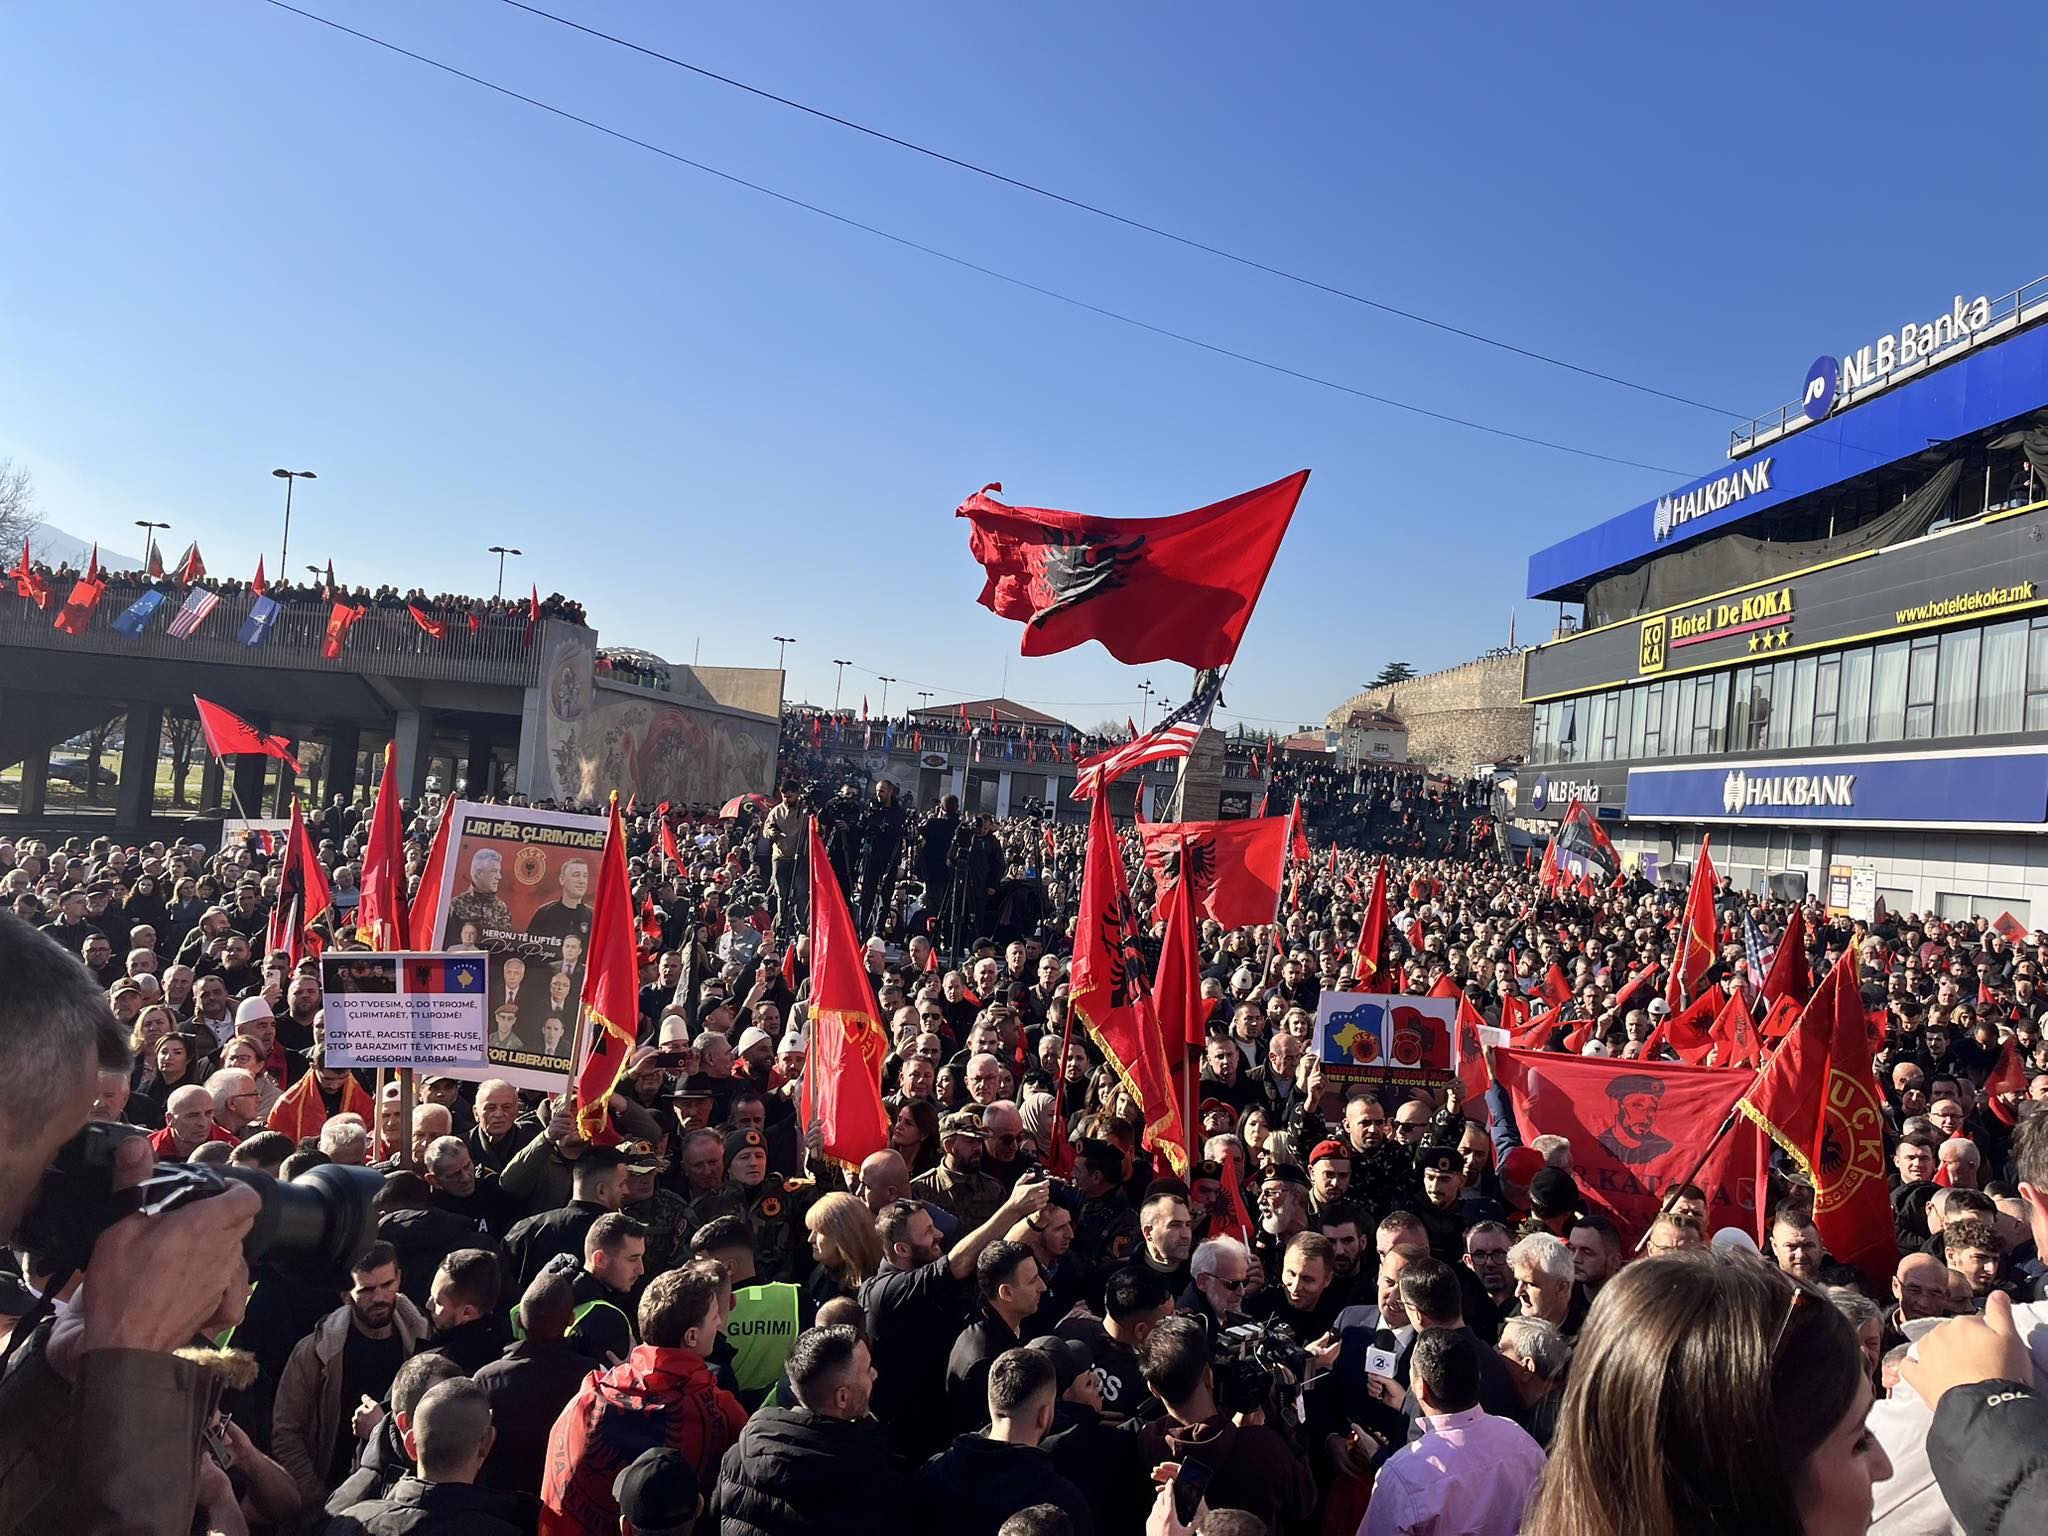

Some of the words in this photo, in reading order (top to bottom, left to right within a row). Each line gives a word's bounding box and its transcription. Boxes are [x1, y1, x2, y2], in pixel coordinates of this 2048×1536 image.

[1843, 336, 1895, 391] NLB
[1901, 296, 1990, 366] Banka
[1672, 458, 1773, 526] HALKBANK
[1896, 581, 2034, 624] www.hoteldekoka.mk
[1671, 609, 1712, 640] Hotel
[1645, 626, 1662, 644] KO
[1643, 646, 1661, 666] KA
[1548, 782, 1567, 802] NLB
[1568, 779, 1599, 802] Banka
[1746, 775, 1854, 806] HALKBANK
[466, 820, 491, 835] LIRI
[493, 821, 519, 839] PËR
[482, 929, 516, 940] HERONJ
[518, 933, 528, 942] TË
[529, 935, 562, 947] LUFTËS
[330, 1030, 375, 1040] GJYKATË,
[377, 1031, 417, 1039] RACISTE
[419, 1031, 481, 1041] SERBE-RUSE,
[327, 1043, 353, 1051] STOP
[355, 1043, 408, 1051] BARAZIMIT
[470, 1044, 484, 1052] ME
[356, 1055, 412, 1063] AGRESORIN
[414, 1055, 457, 1063] BARBAR!
[1348, 1075, 1384, 1084] DRIVING
